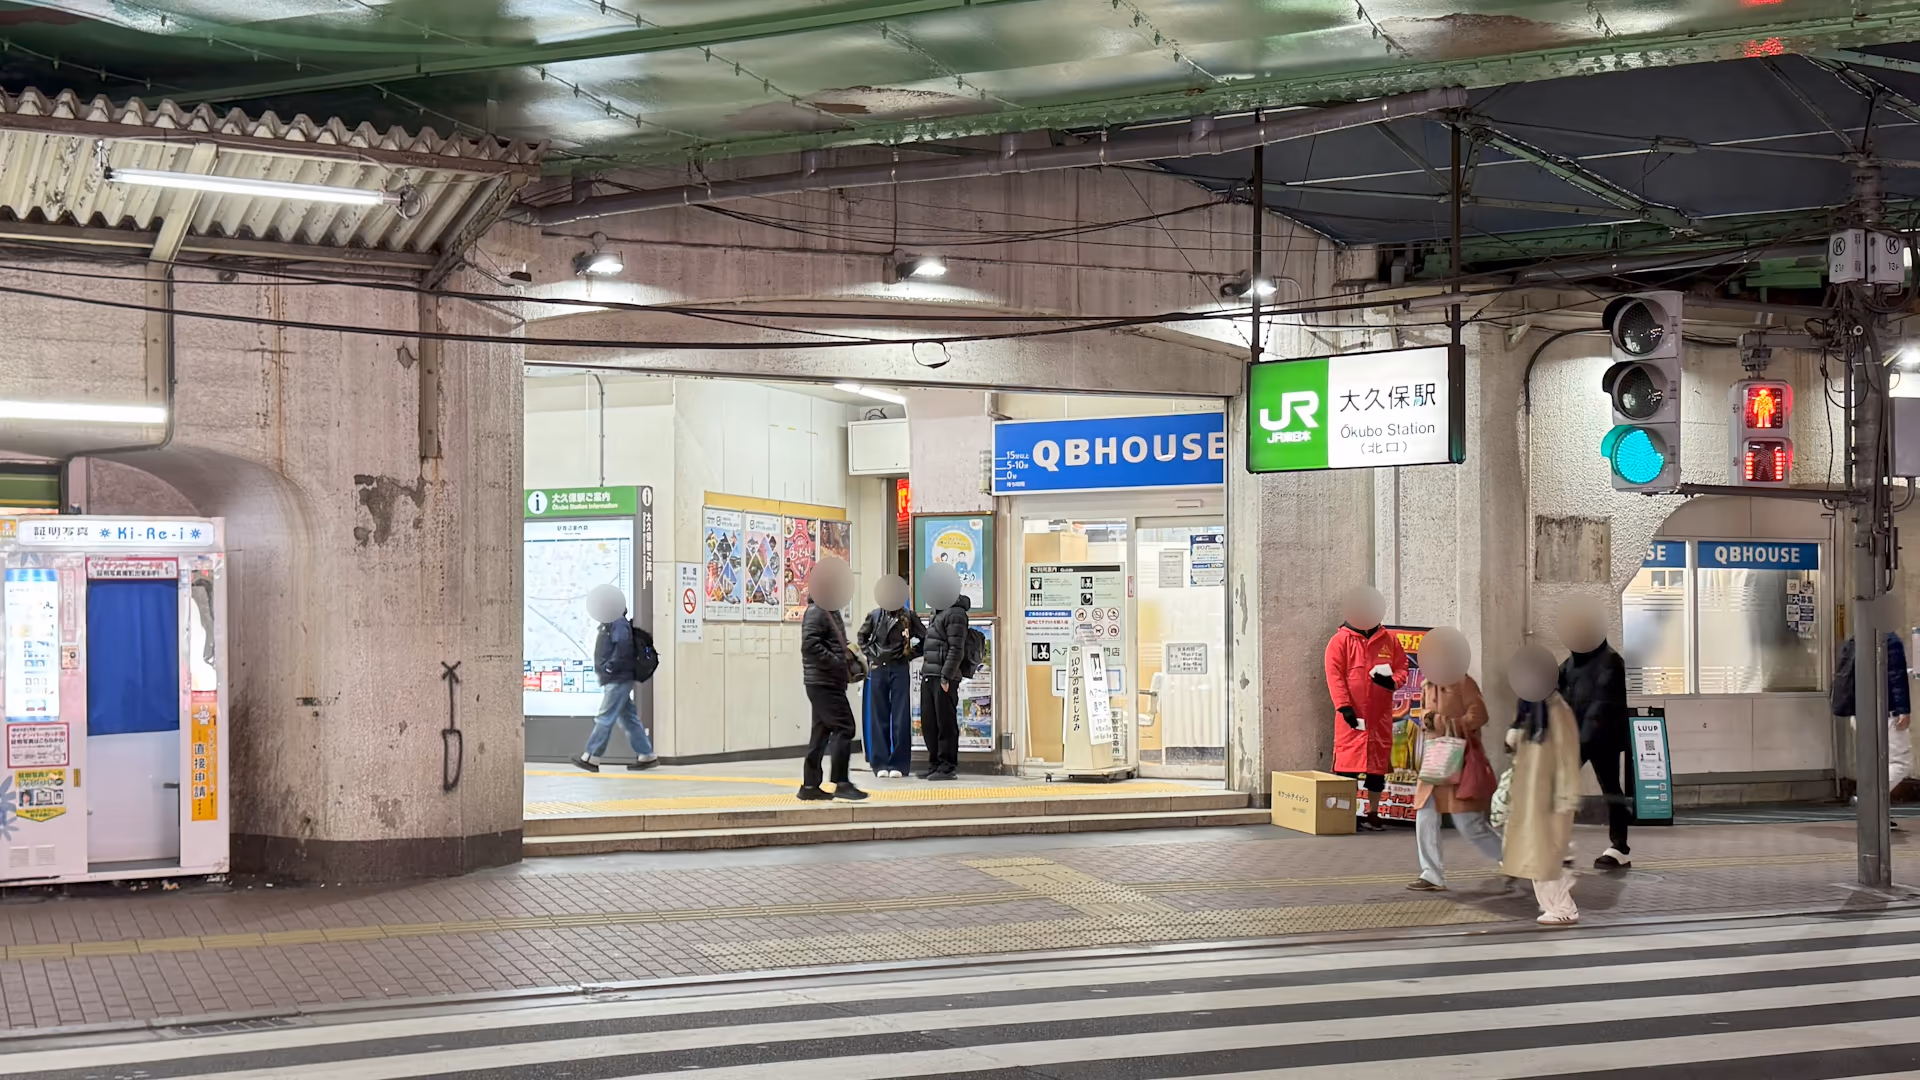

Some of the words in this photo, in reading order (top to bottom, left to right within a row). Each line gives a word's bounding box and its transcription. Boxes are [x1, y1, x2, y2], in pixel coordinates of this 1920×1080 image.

[1339, 383, 1436, 412] 大久保駅
[1259, 390, 1320, 431] JR
[1387, 423, 1436, 437] Station
[551, 491, 611, 504] 大久保駅ご案内
[588, 502, 618, 510] Information
[33, 526, 89, 537] 証明写真
[1714, 545, 1801, 565] QBHOUSE
[193, 743, 206, 799] 直接申請
